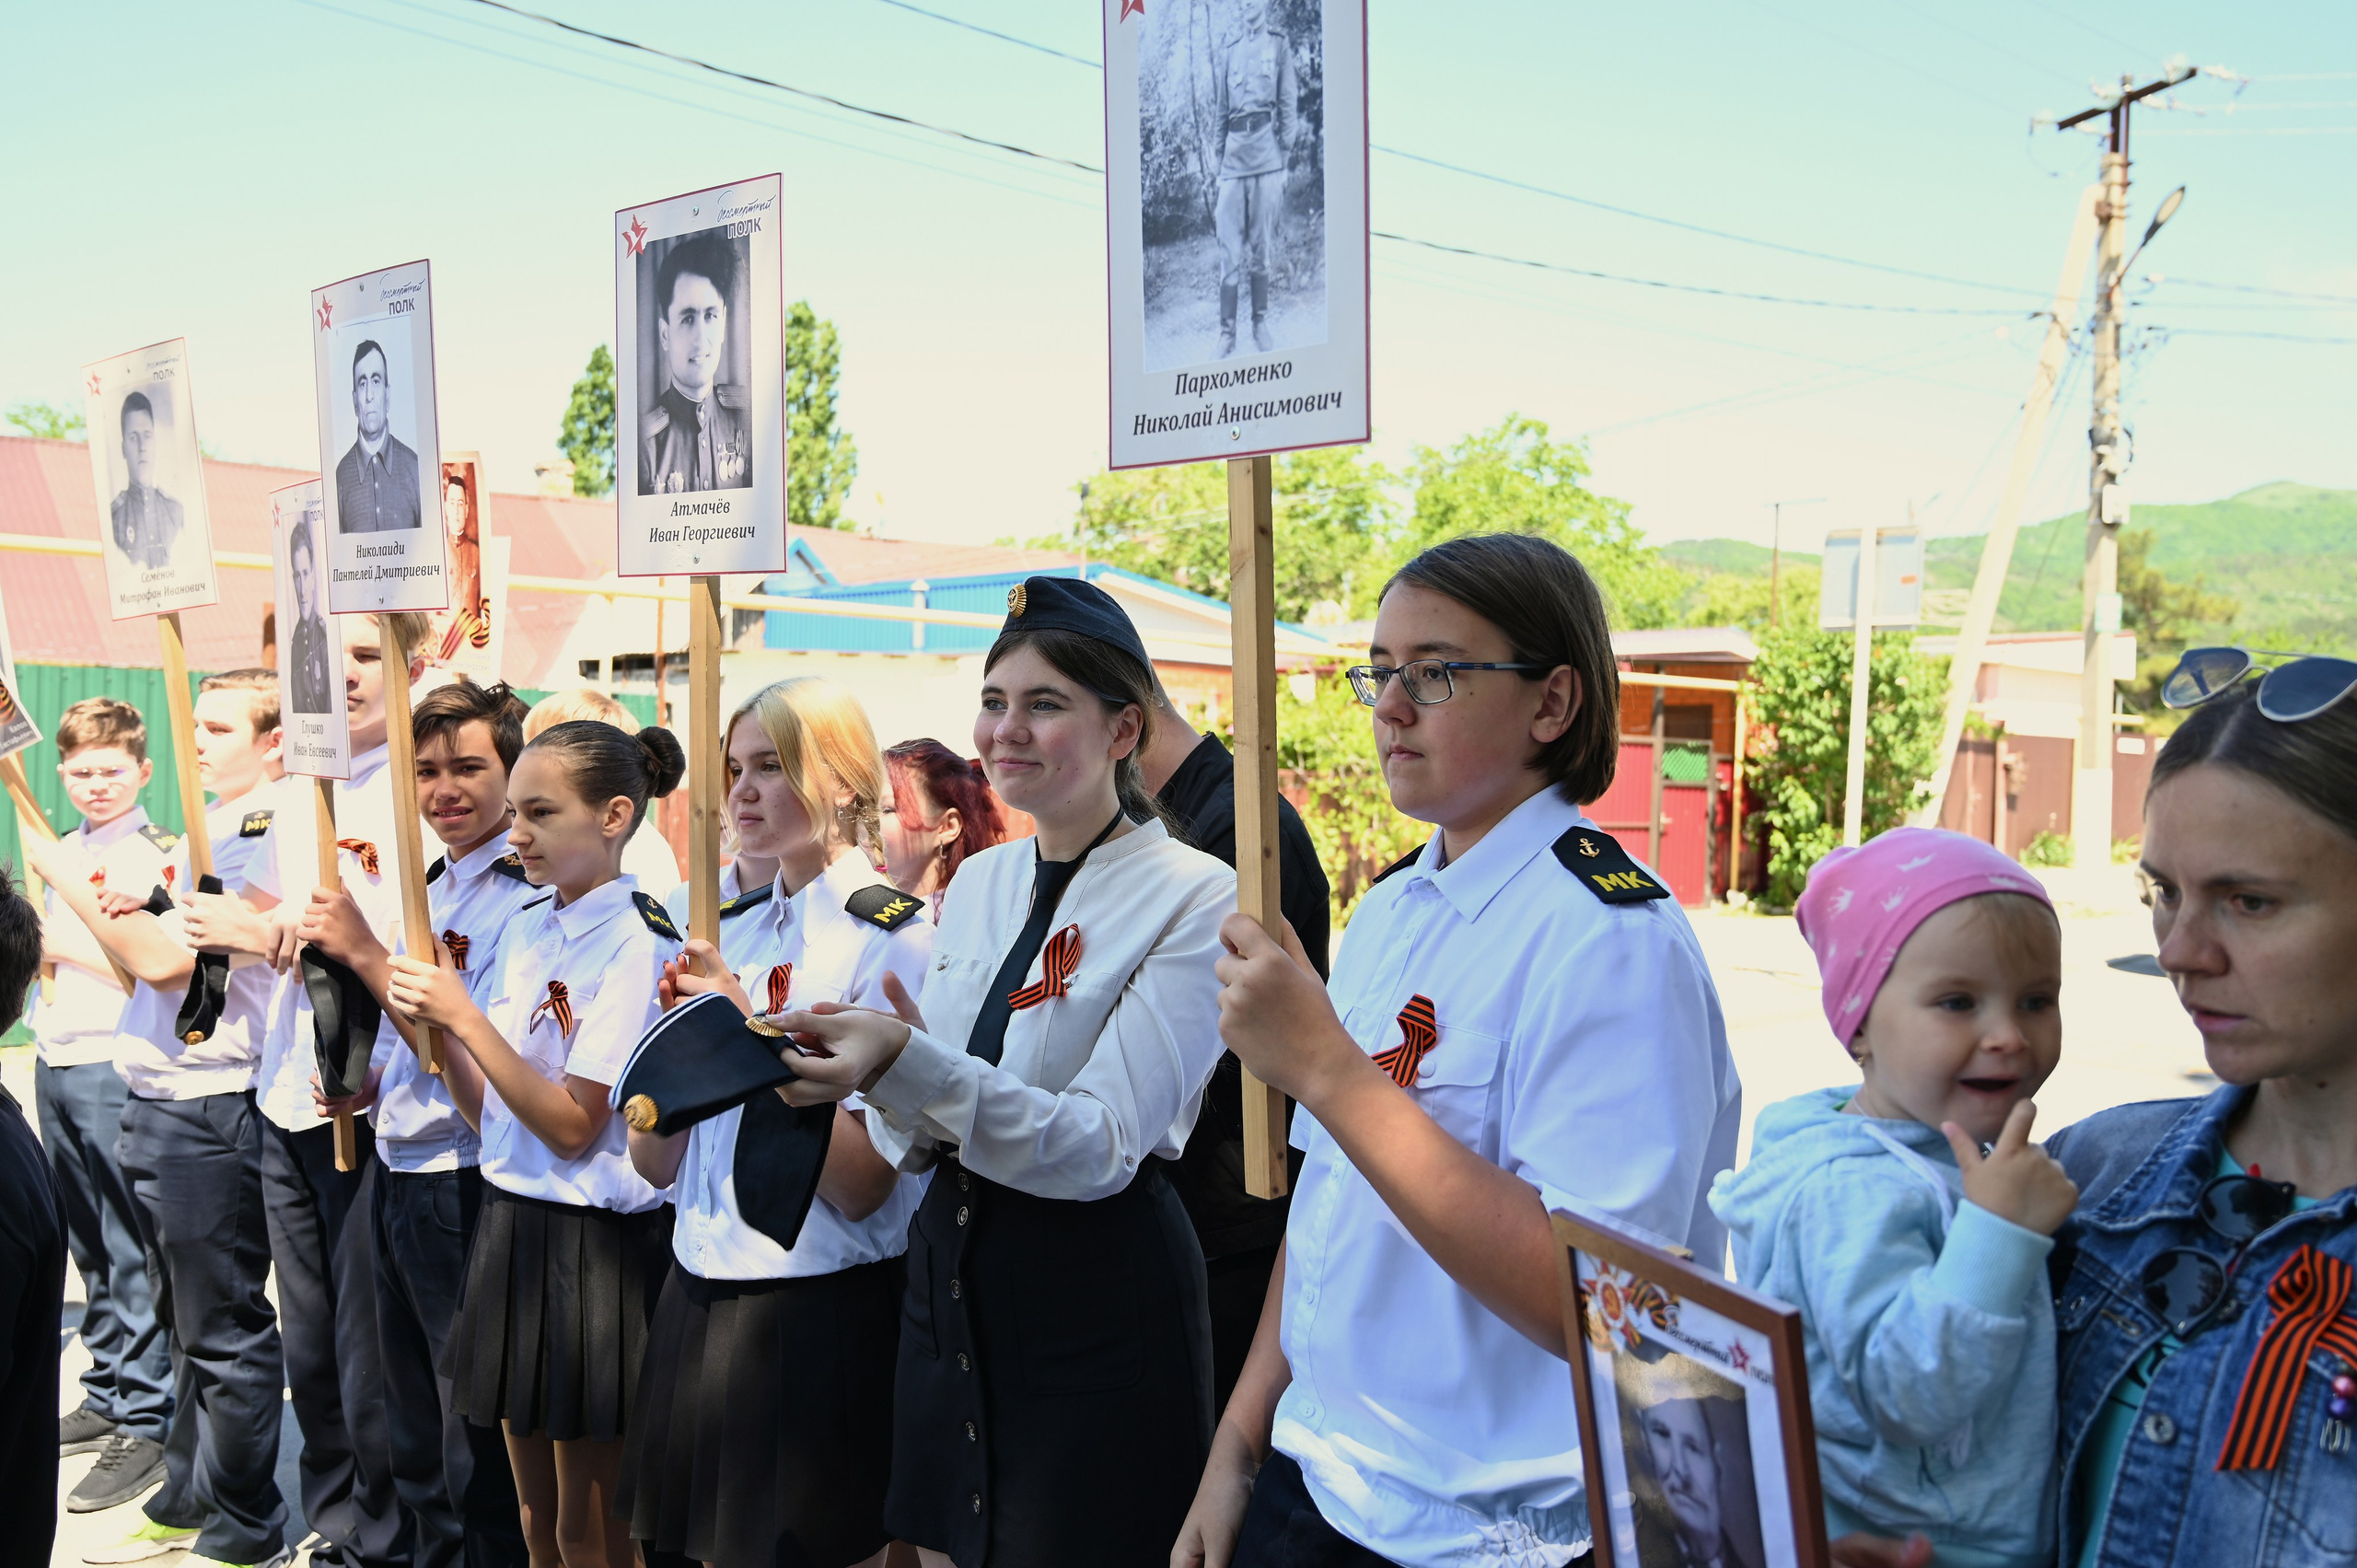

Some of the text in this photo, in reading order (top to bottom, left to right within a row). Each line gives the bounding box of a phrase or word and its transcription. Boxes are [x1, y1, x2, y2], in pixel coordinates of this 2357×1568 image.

[727, 217, 762, 239] ПОЛК
[389, 298, 415, 316] ПОЛК
[153, 367, 176, 381] ПОЛК
[1175, 361, 1293, 398] Пархоменко
[1132, 391, 1342, 436] Николай Анисимович
[670, 498, 730, 517] Атмачёв
[649, 526, 755, 545] Иван Георгиевич
[356, 541, 405, 559] Николаиди
[141, 570, 175, 584] Семёнов
[332, 564, 440, 583] Пантелей Дмитриевич
[120, 583, 205, 605] Митрофан Иванович
[302, 720, 324, 738] Глушко
[294, 741, 337, 759] Иван Евсеевич
[1591, 871, 1655, 892] МК
[874, 897, 913, 923] МК
[646, 911, 677, 933] МК
